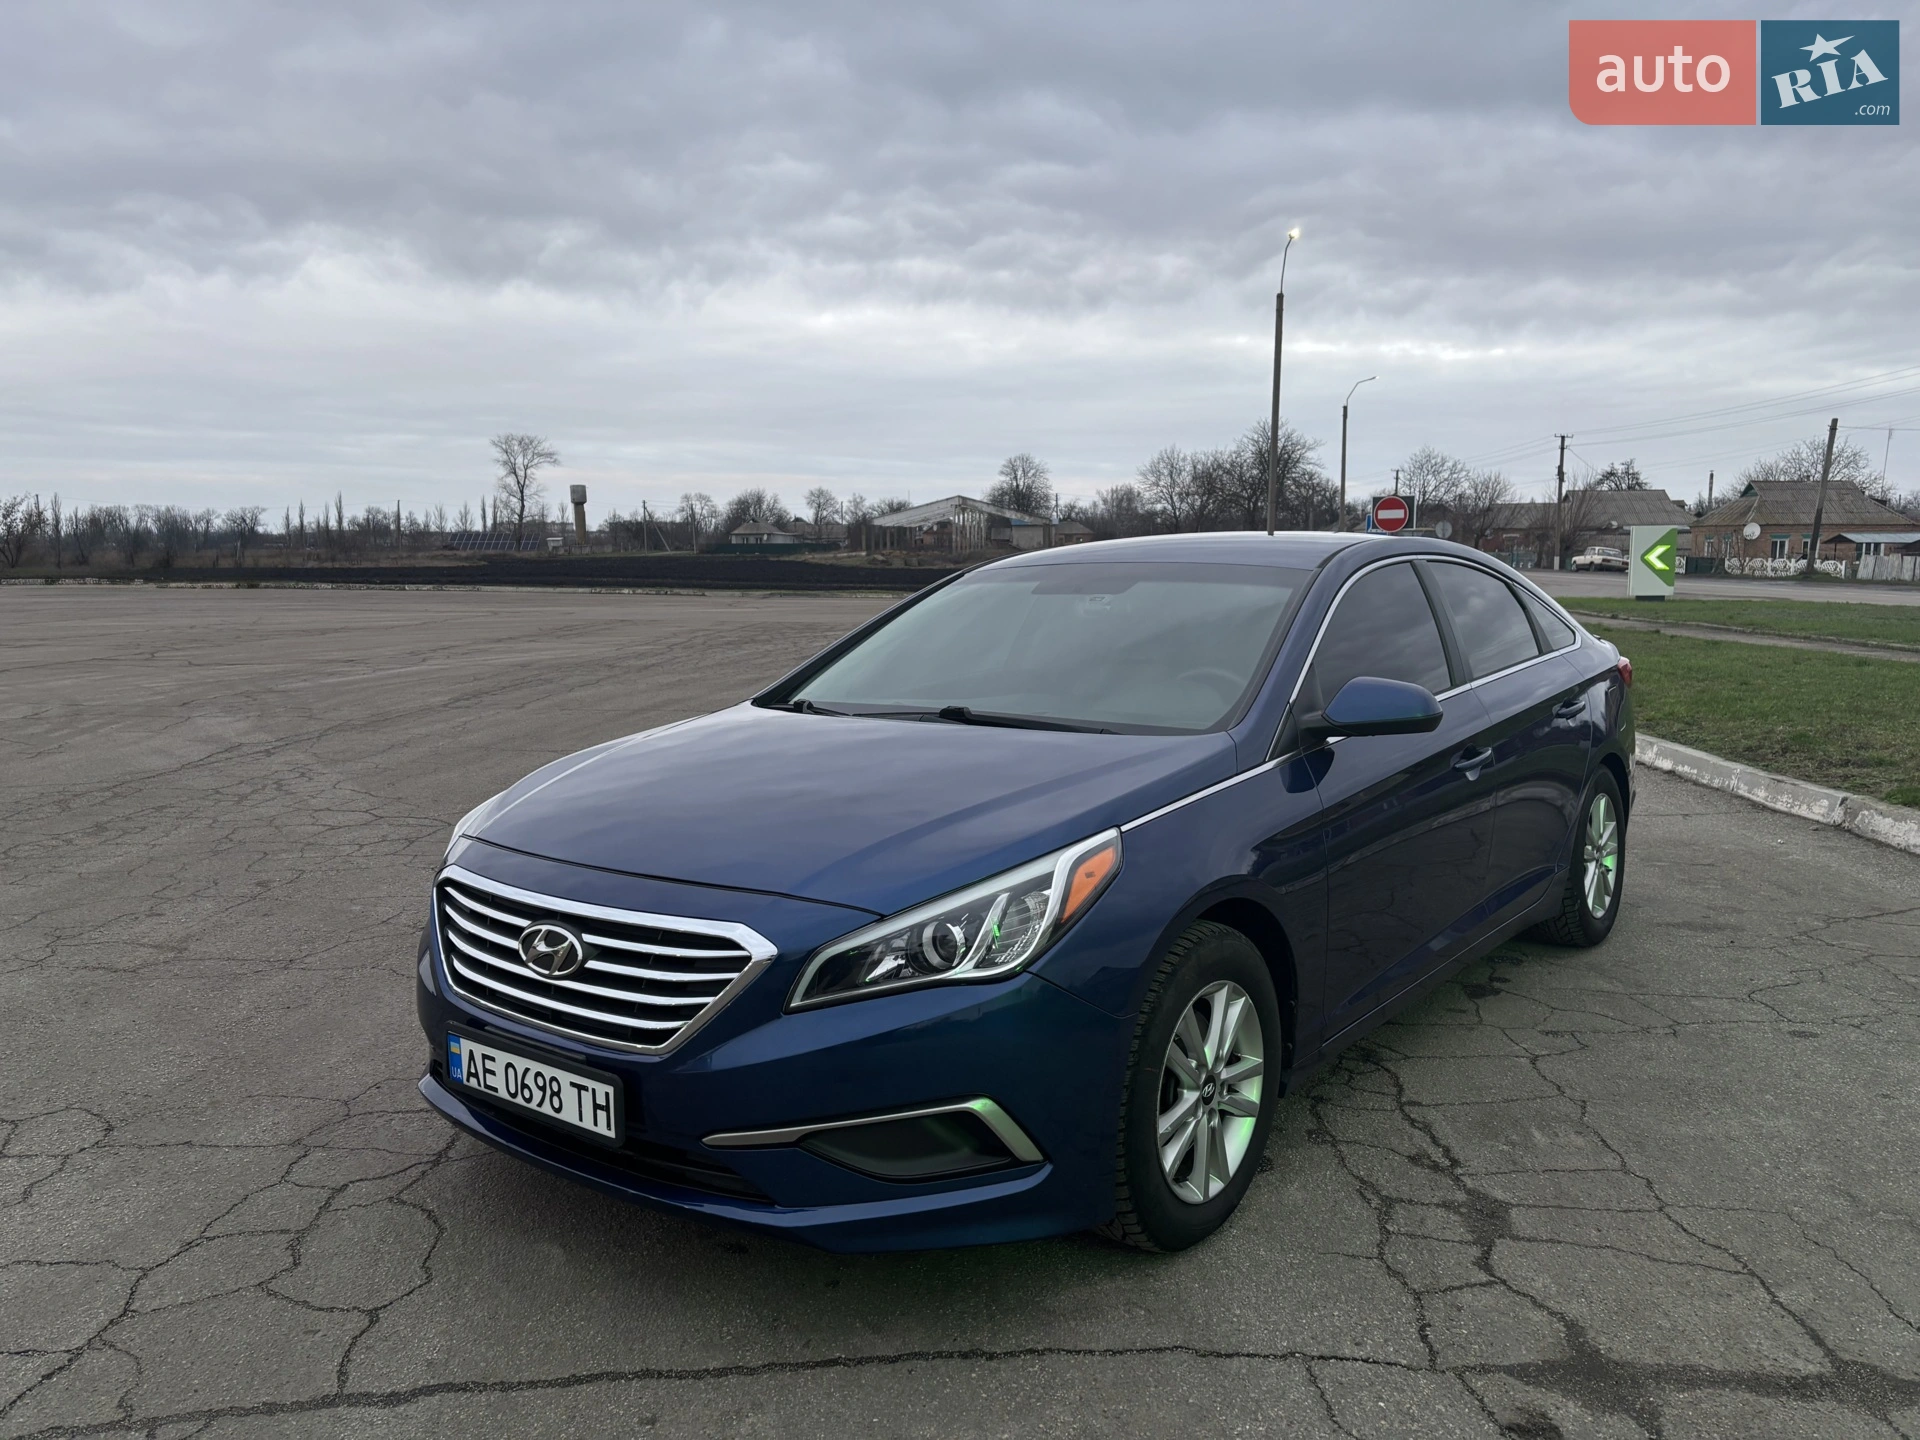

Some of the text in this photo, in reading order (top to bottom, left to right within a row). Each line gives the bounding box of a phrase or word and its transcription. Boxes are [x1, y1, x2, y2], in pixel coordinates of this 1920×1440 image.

[451, 1066, 463, 1080] UA
[465, 1048, 612, 1132] AE 0698 TH
